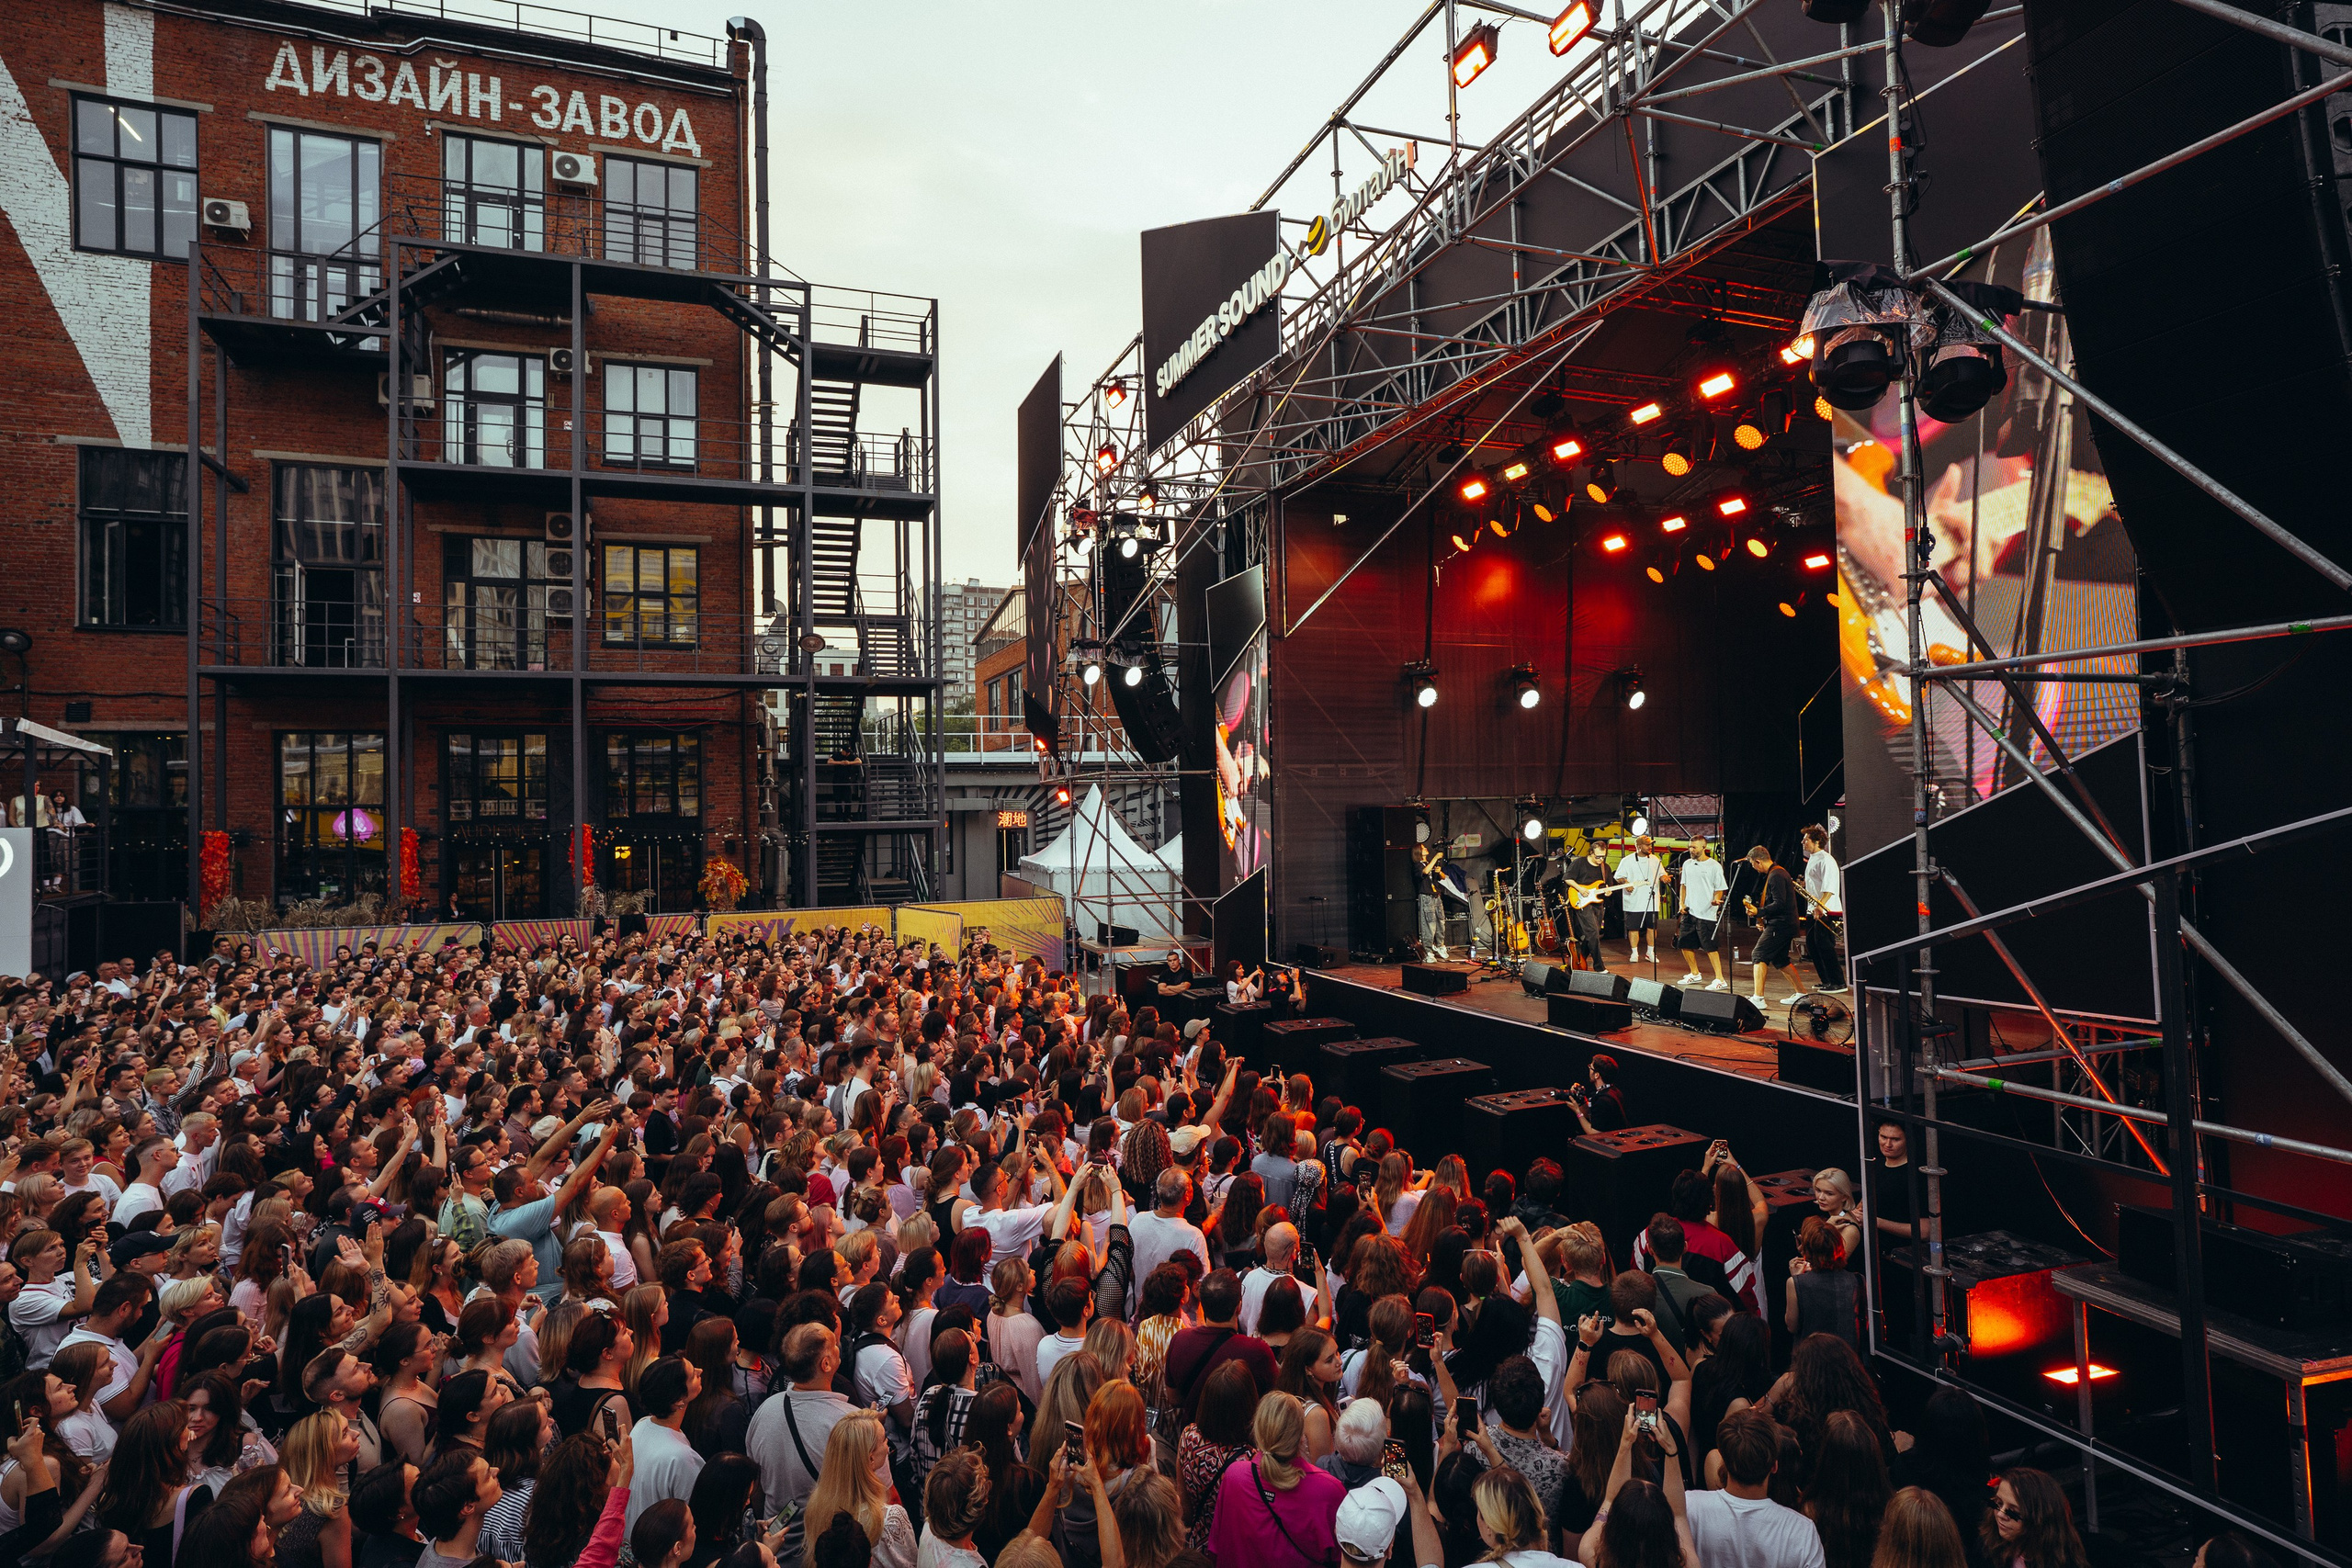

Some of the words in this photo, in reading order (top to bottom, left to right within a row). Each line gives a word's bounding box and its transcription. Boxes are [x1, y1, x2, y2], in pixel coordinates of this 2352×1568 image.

[265, 40, 702, 157] ДИЗАЙН-ЗАВОД
[1330, 141, 1415, 234] билайн
[1156, 314, 1223, 398] SUMMER
[1218, 253, 1291, 337] SOUND
[998, 811, 1027, 828] 潮地
